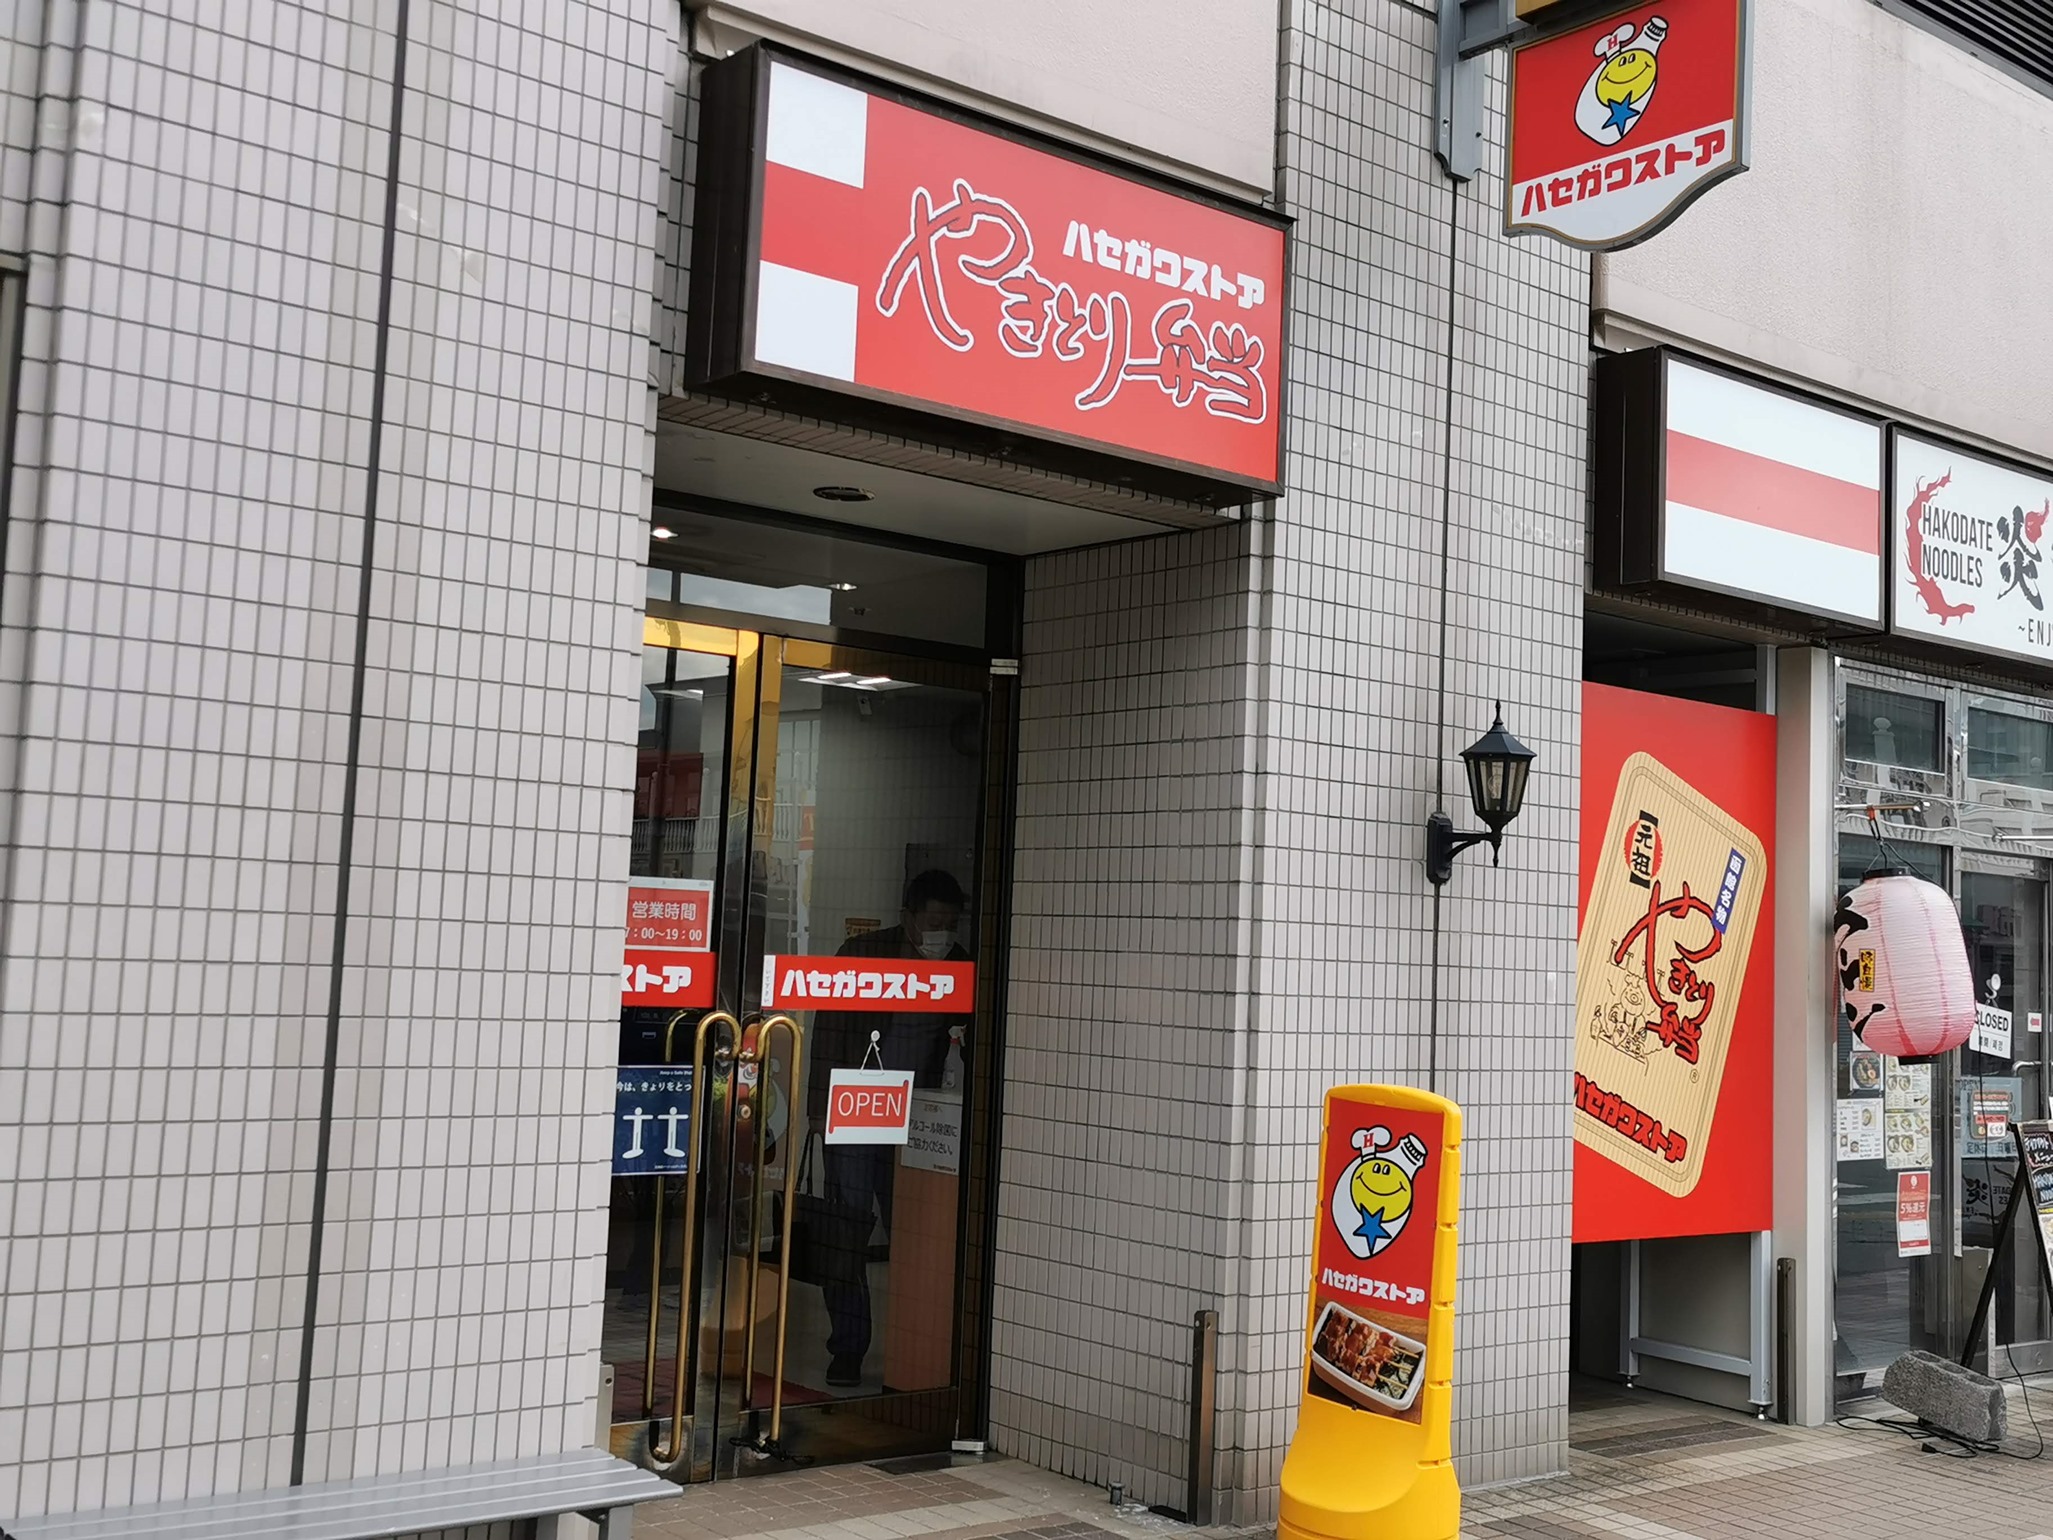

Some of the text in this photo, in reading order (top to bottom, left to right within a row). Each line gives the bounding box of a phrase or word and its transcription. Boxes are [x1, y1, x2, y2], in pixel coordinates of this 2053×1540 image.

[1520, 128, 1726, 217] ハセガワストア
[1062, 220, 1265, 309] ハセガワストア
[876, 178, 1268, 424] やきとり弁当
[1922, 503, 1993, 552] HAKODATE
[1922, 543, 1983, 588] NOODLES
[632, 900, 697, 921] 営業時間
[1715, 854, 1743, 926] 函館名物
[780, 969, 955, 1000] ハセガワストア
[837, 1091, 902, 1118] OPEN
[1574, 1071, 1688, 1164] ハセガワストア
[1321, 1266, 1426, 1306] ハセガワストア
